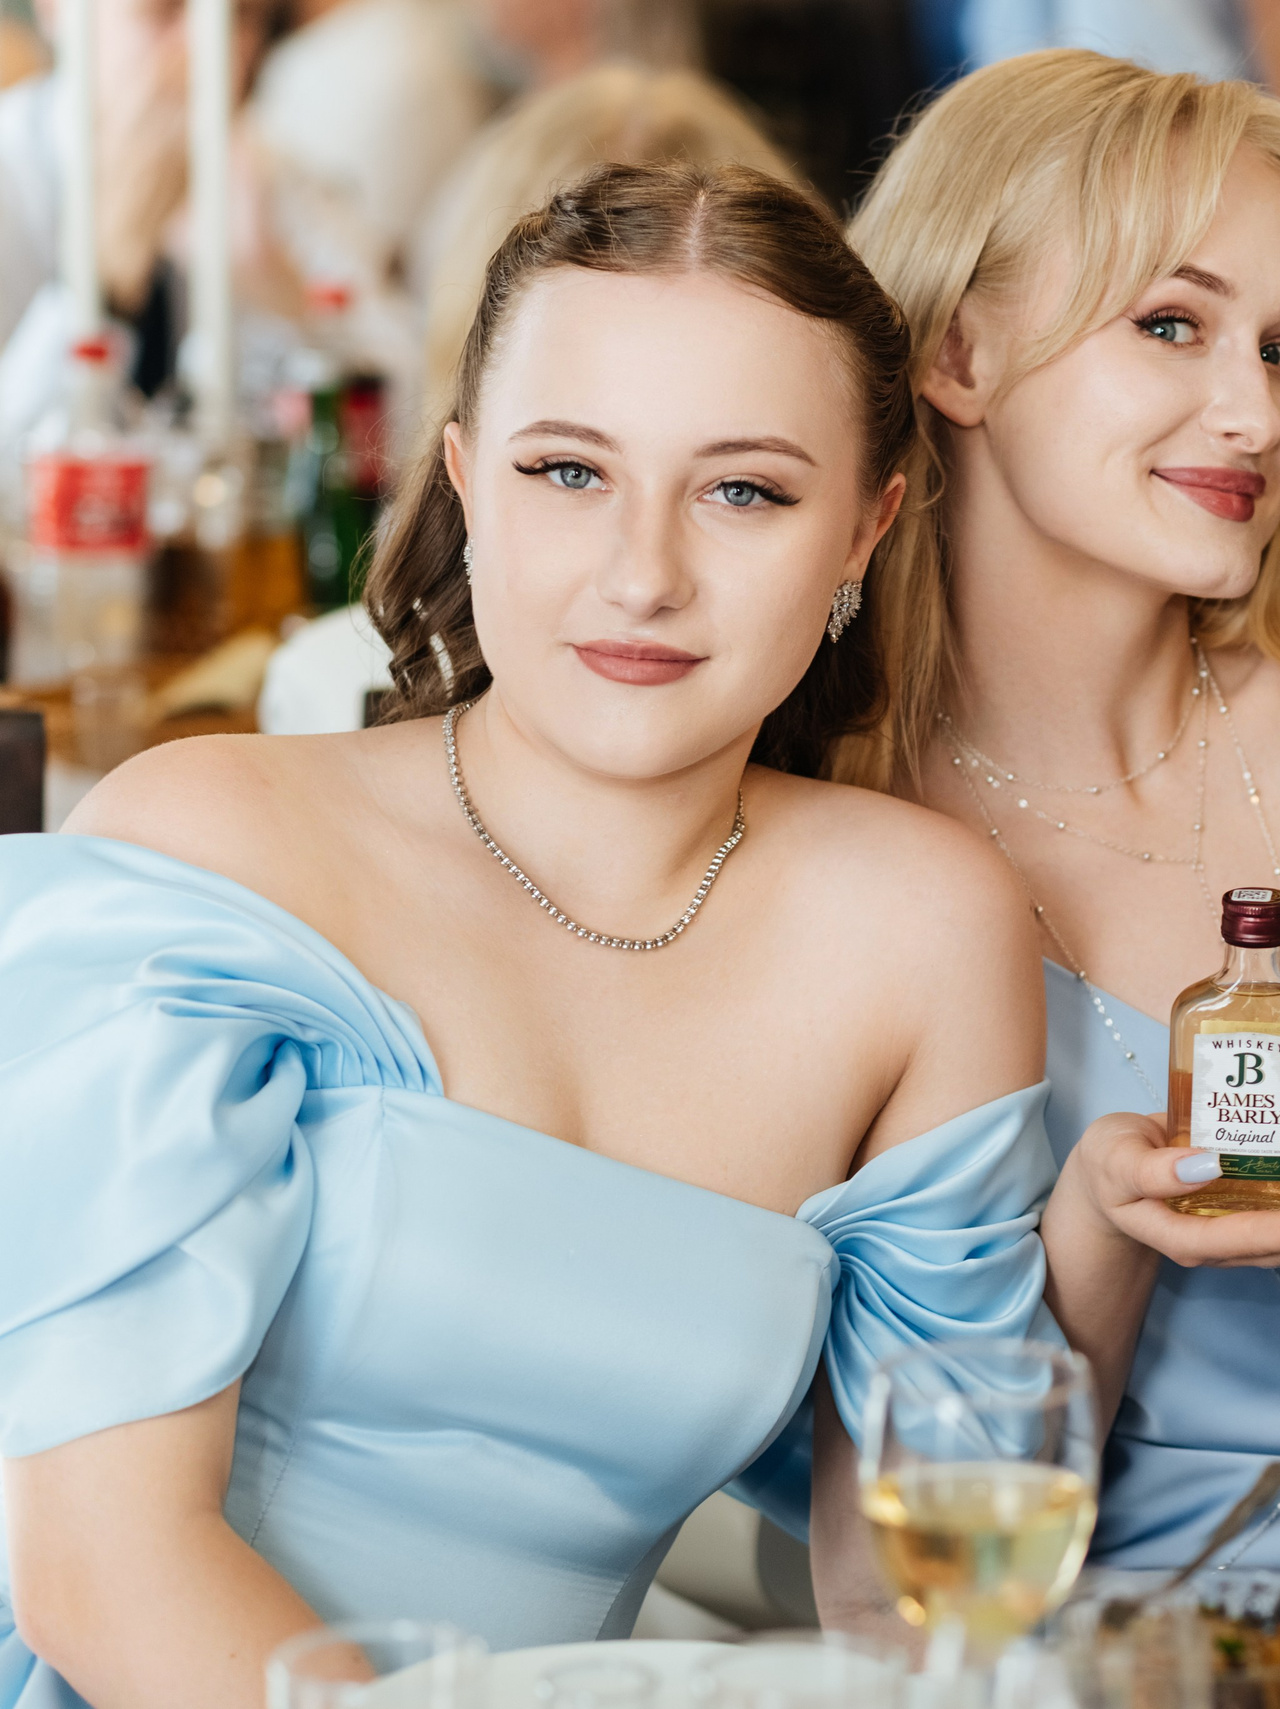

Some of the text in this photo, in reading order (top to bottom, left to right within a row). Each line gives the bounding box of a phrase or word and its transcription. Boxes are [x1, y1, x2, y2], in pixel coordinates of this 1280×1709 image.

[1225, 1052, 1265, 1088] JB
[1207, 1091, 1275, 1109] JAMES
[1215, 1127, 1276, 1146] Original
